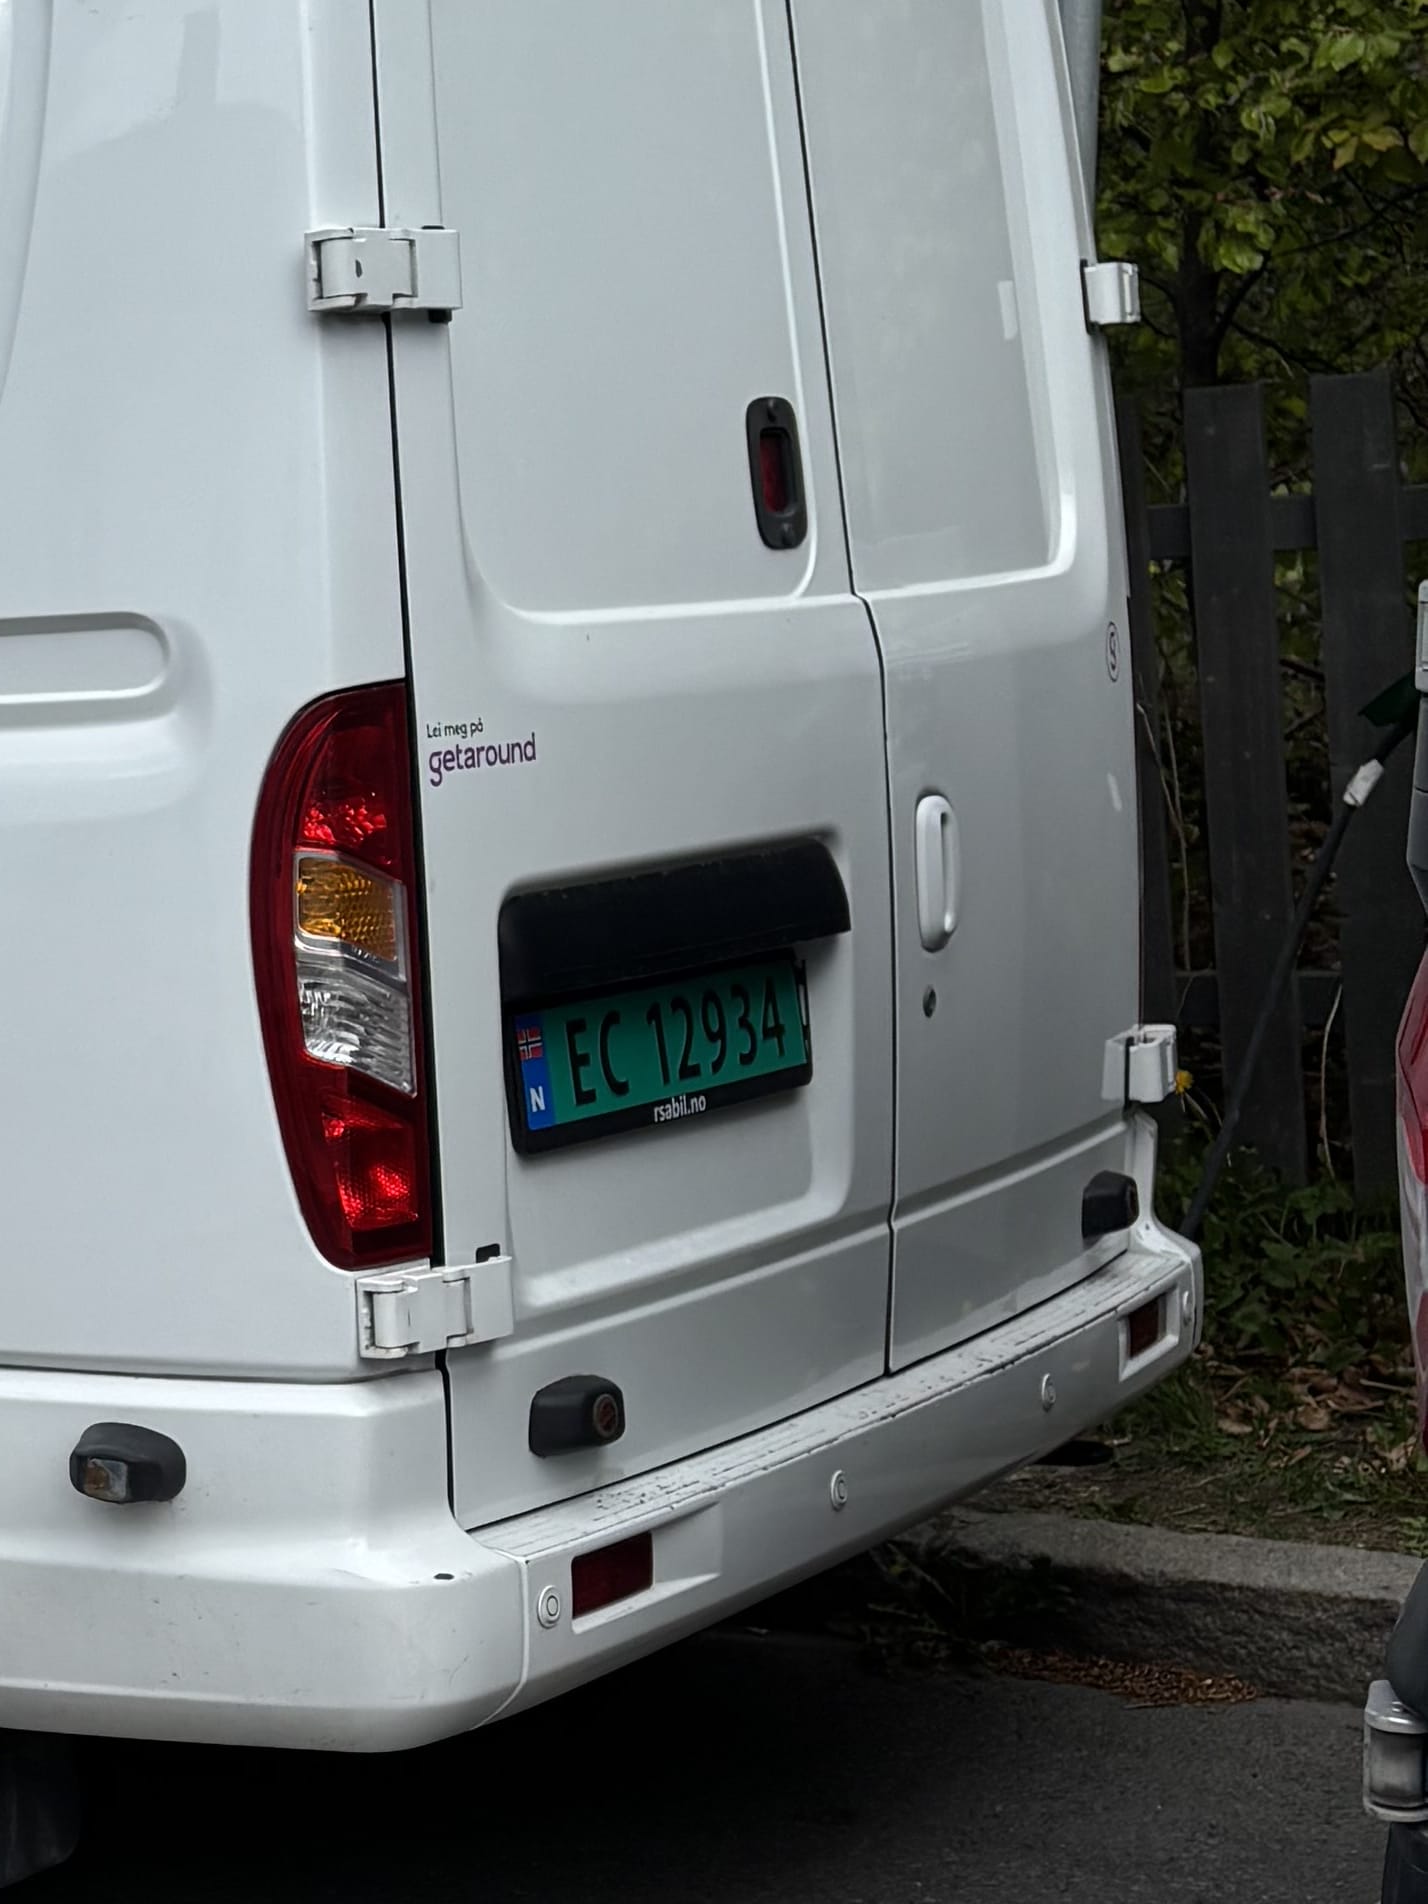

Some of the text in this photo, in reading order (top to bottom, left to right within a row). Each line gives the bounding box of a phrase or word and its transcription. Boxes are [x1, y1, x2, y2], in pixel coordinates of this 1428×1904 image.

[426, 716, 484, 739] Lei meg på
[428, 731, 537, 788] getaround
[564, 975, 787, 1107] EC 12934
[529, 1085, 546, 1113] N
[653, 1093, 707, 1123] rsabil.no
